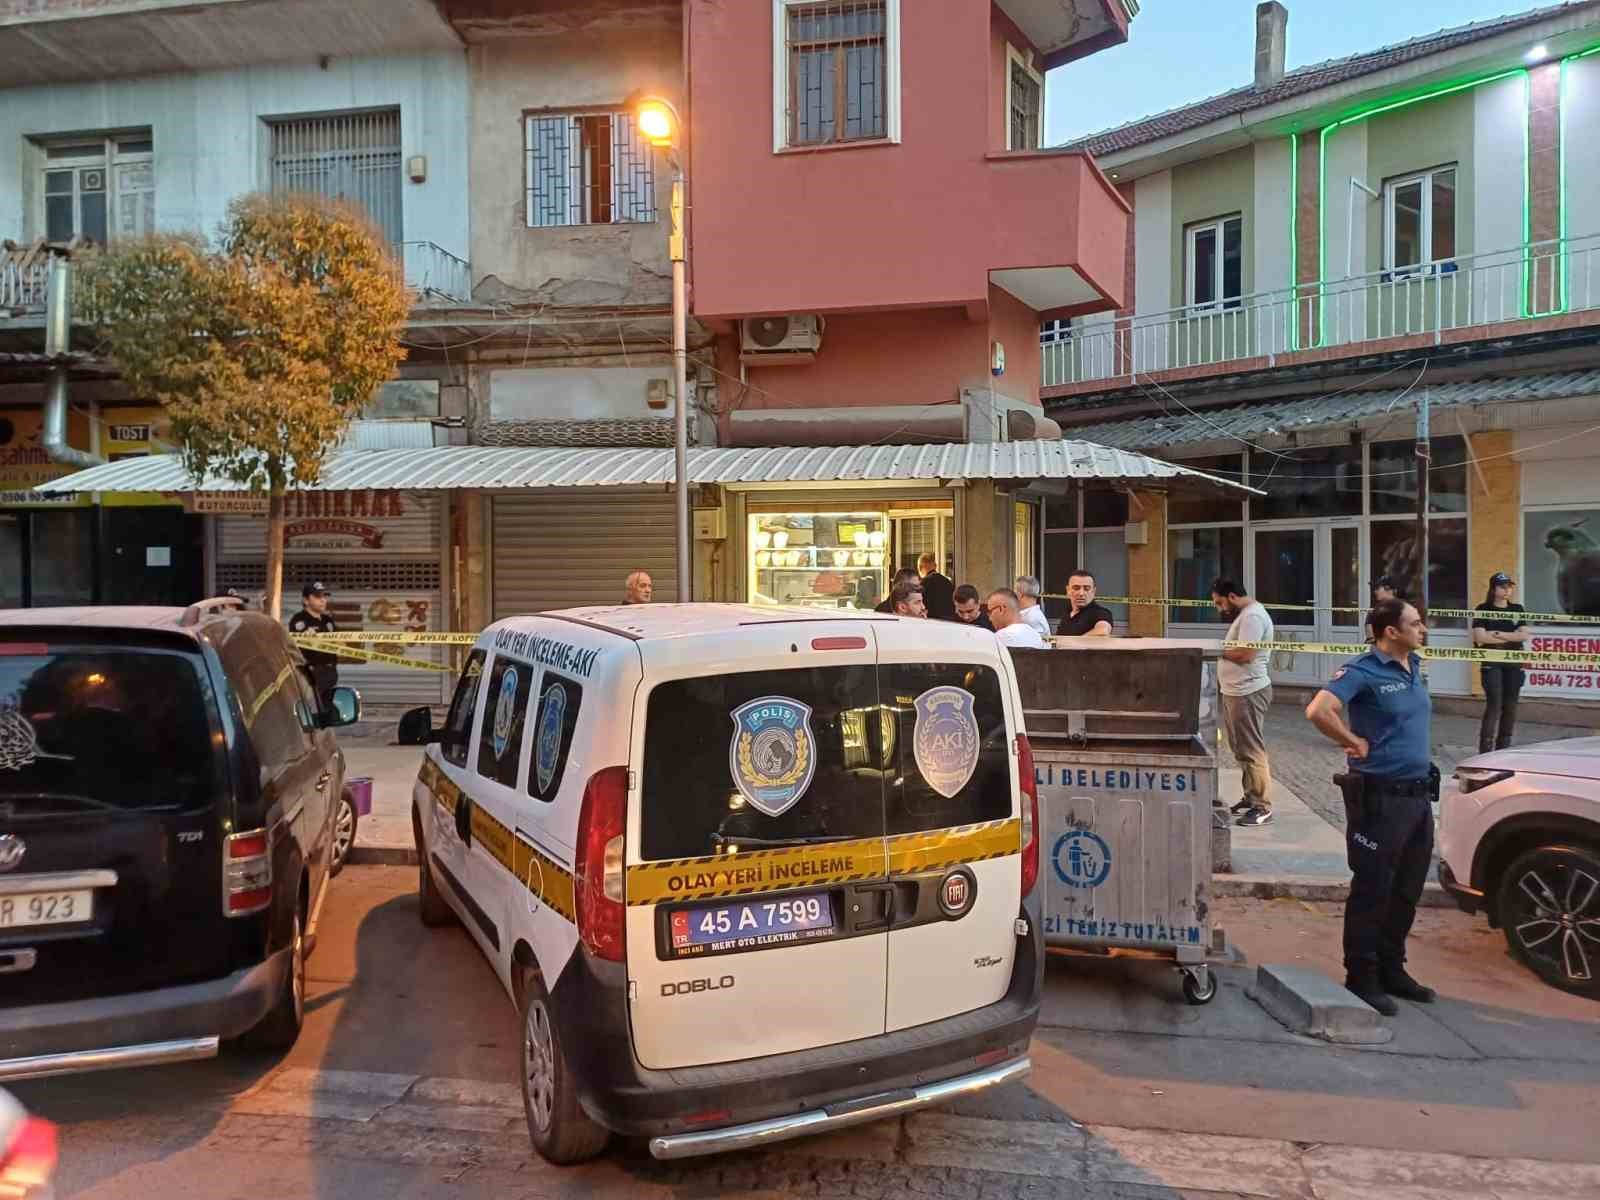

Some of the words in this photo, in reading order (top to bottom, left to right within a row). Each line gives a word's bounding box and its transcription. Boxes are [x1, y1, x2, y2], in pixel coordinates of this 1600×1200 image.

[115, 425, 145, 440] TOST
[1530, 673, 1562, 687] 0544
[1567, 674, 1593, 688] 723
[1061, 767, 1197, 792] BELEDİYESİ
[668, 872, 718, 892] OLAY
[722, 862, 763, 886] YERİ
[769, 856, 854, 881] İNCELEME
[948, 884, 965, 901] FIAT
[29, 894, 75, 921] 923
[700, 909, 731, 934] 45
[738, 906, 759, 931] A
[763, 898, 821, 926] 7599
[674, 934, 689, 944] TR
[711, 938, 736, 951] MERT
[738, 936, 756, 947] OTO
[660, 974, 735, 997] DOBLO
